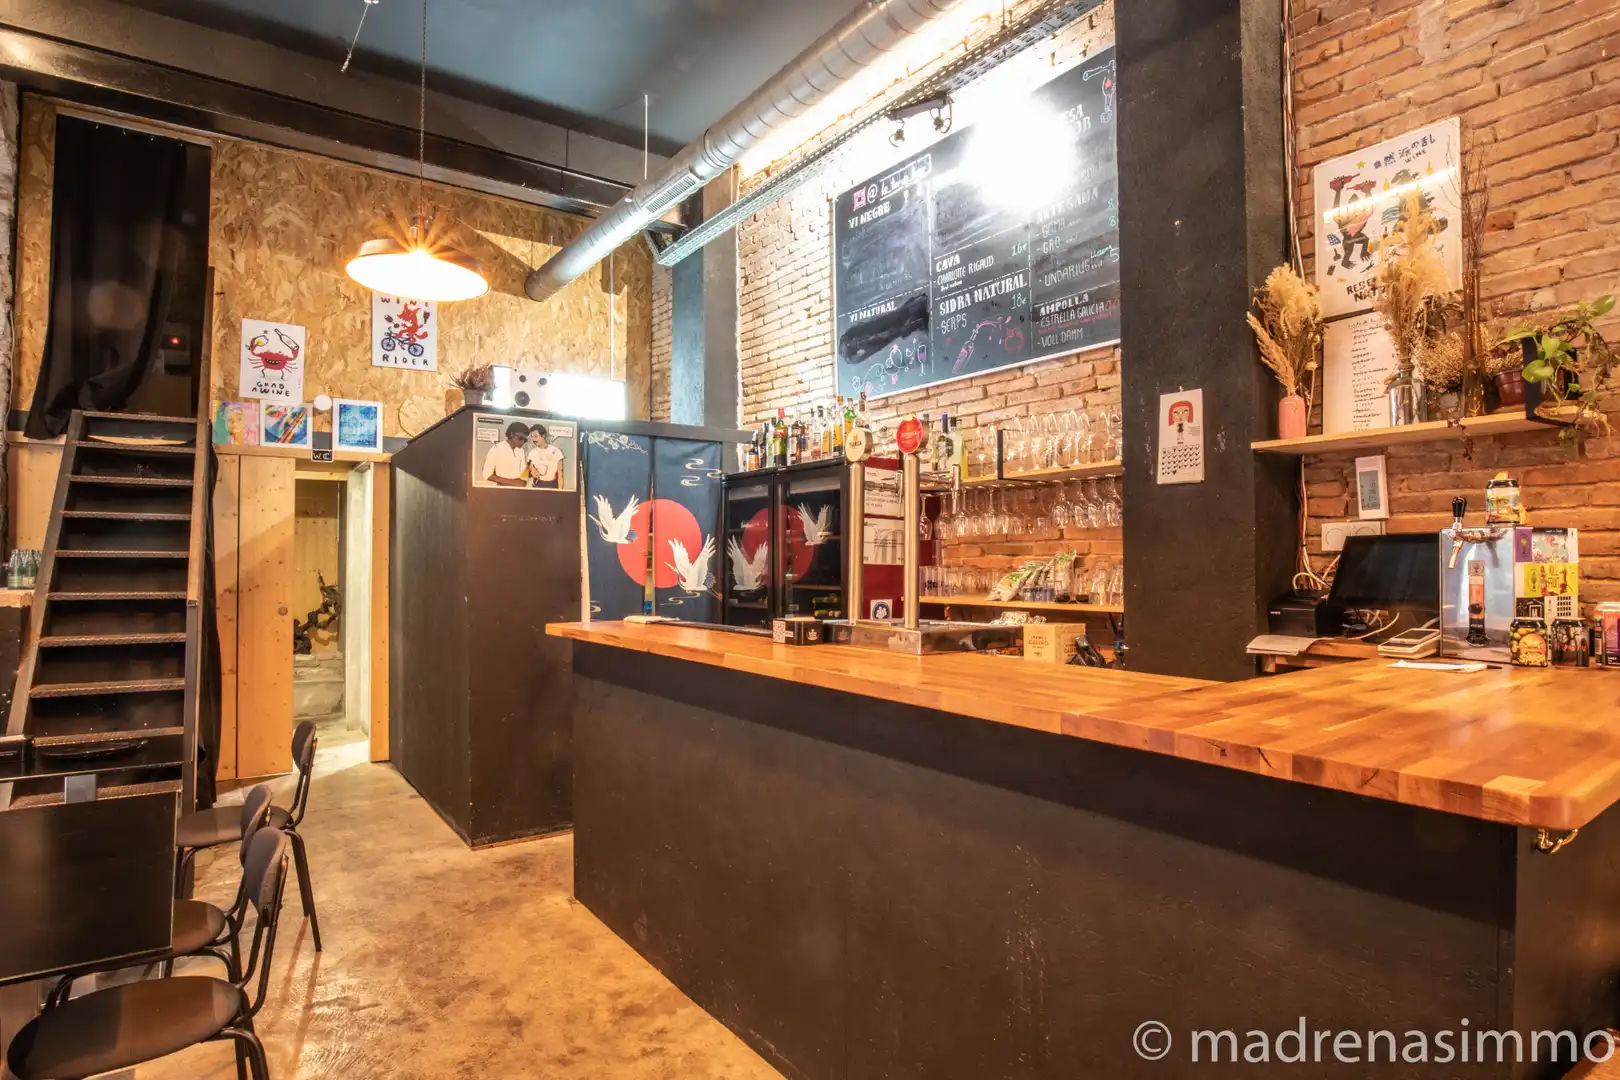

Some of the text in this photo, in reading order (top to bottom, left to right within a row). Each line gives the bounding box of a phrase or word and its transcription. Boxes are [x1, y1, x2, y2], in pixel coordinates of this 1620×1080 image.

[1404, 148, 1427, 163] WINE
[847, 201, 891, 229] VI NEGRE
[936, 254, 961, 273] CAVA
[968, 255, 994, 274] RIGAUD
[380, 296, 429, 308] WINE
[939, 273, 1027, 315] SIDRA NATURAL
[859, 300, 897, 320] NATURAL
[1039, 292, 1089, 317] AMPOLLA
[1040, 309, 1075, 328] ESTRELLA
[1077, 301, 1104, 319] GALICIA
[1041, 327, 1084, 348] VOLL DAMM
[382, 353, 429, 366] RIDER
[260, 388, 290, 397] WINE
